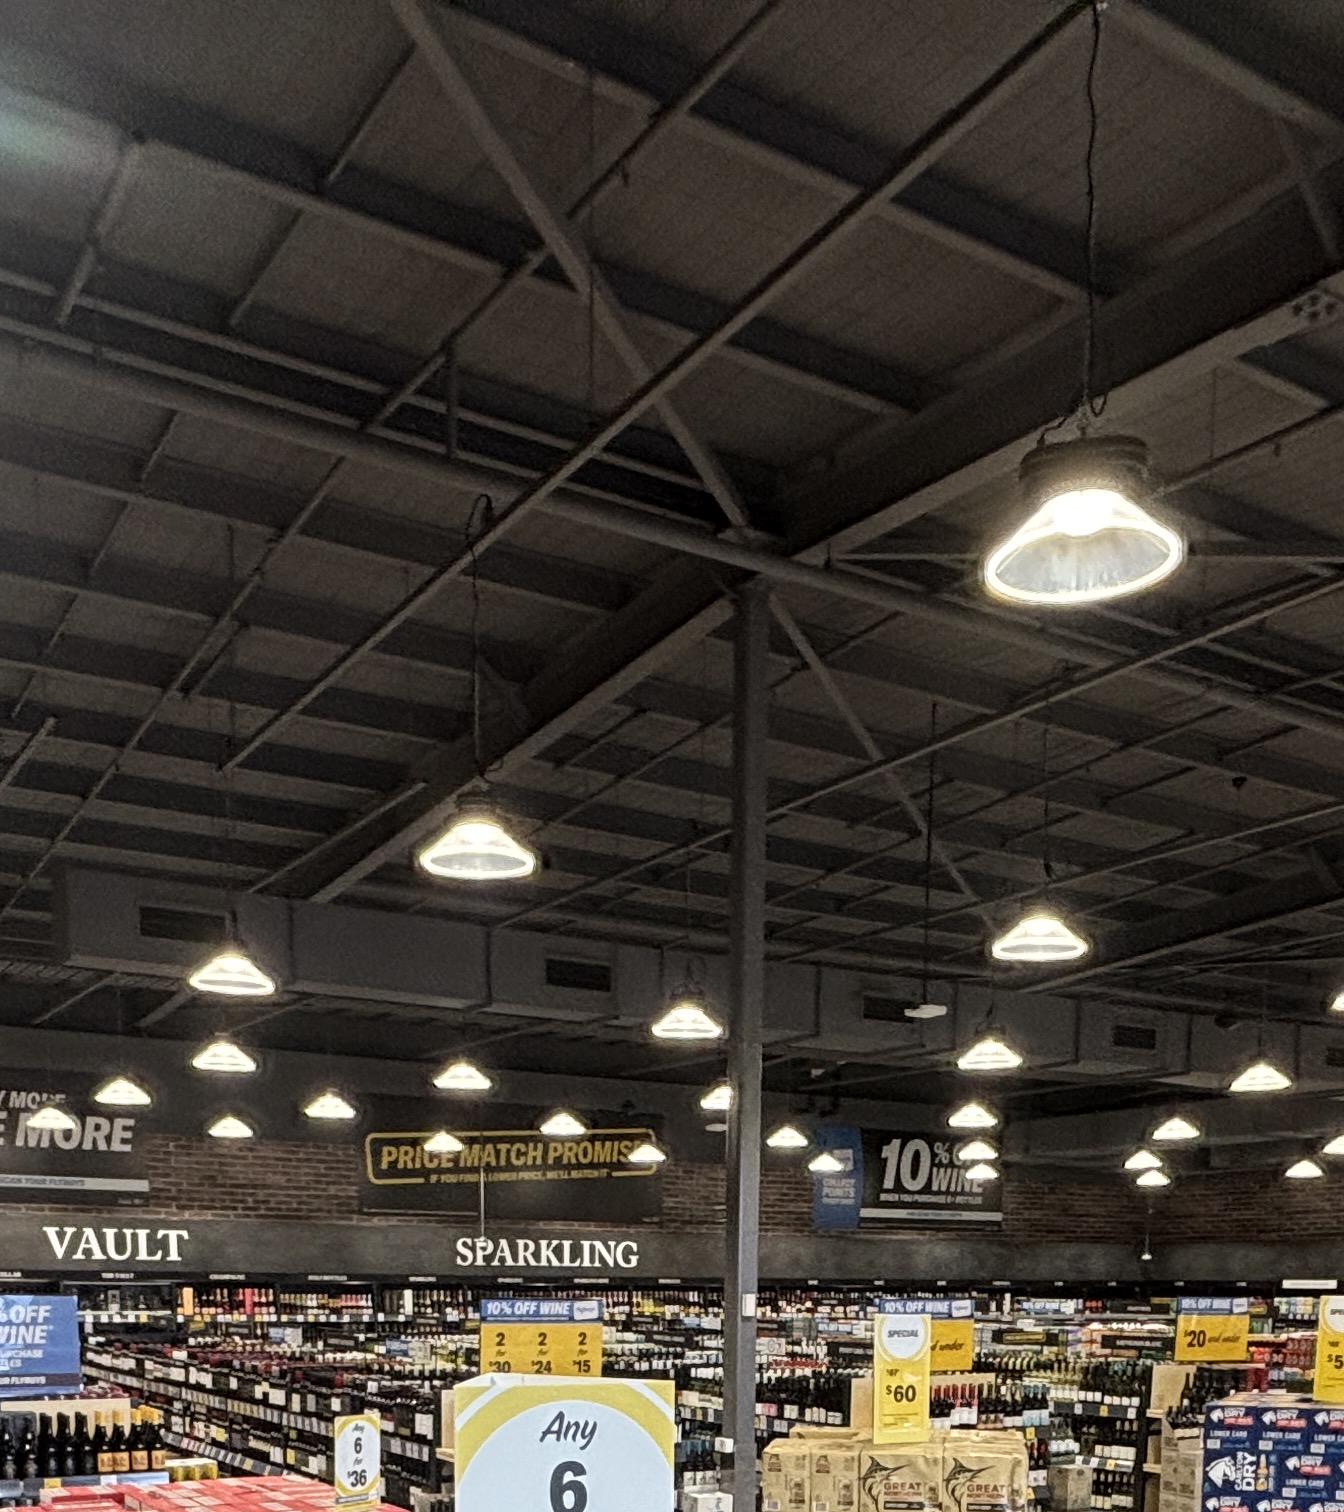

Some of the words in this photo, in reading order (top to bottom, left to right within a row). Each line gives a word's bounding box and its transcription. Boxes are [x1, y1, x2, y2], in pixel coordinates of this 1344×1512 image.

[459, 1143, 544, 1168] MATCH
[42, 1226, 189, 1261] VAULT
[457, 1237, 639, 1267] SPARKLING
[9, 1304, 51, 1323] OFF
[487, 1302, 512, 1316] 10%
[514, 1301, 538, 1315] OFF
[539, 1301, 571, 1315] WINE
[884, 1302, 904, 1313] 10%
[906, 1301, 925, 1313] OFF
[496, 1332, 505, 1346] 2
[538, 1332, 547, 1346] 2
[578, 1332, 587, 1346] 2
[887, 1329, 919, 1338] SPECIAL
[1184, 1330, 1206, 1347] $20
[886, 1384, 916, 1403] $60
[539, 1411, 597, 1450] Any
[354, 1437, 362, 1454] 6
[347, 1469, 367, 1487] $36
[1235, 1451, 1244, 1491] CARLTON
[1242, 1452, 1257, 1492] DRY
[883, 1482, 922, 1491] GREAT
[966, 1483, 1006, 1493] GREAT
